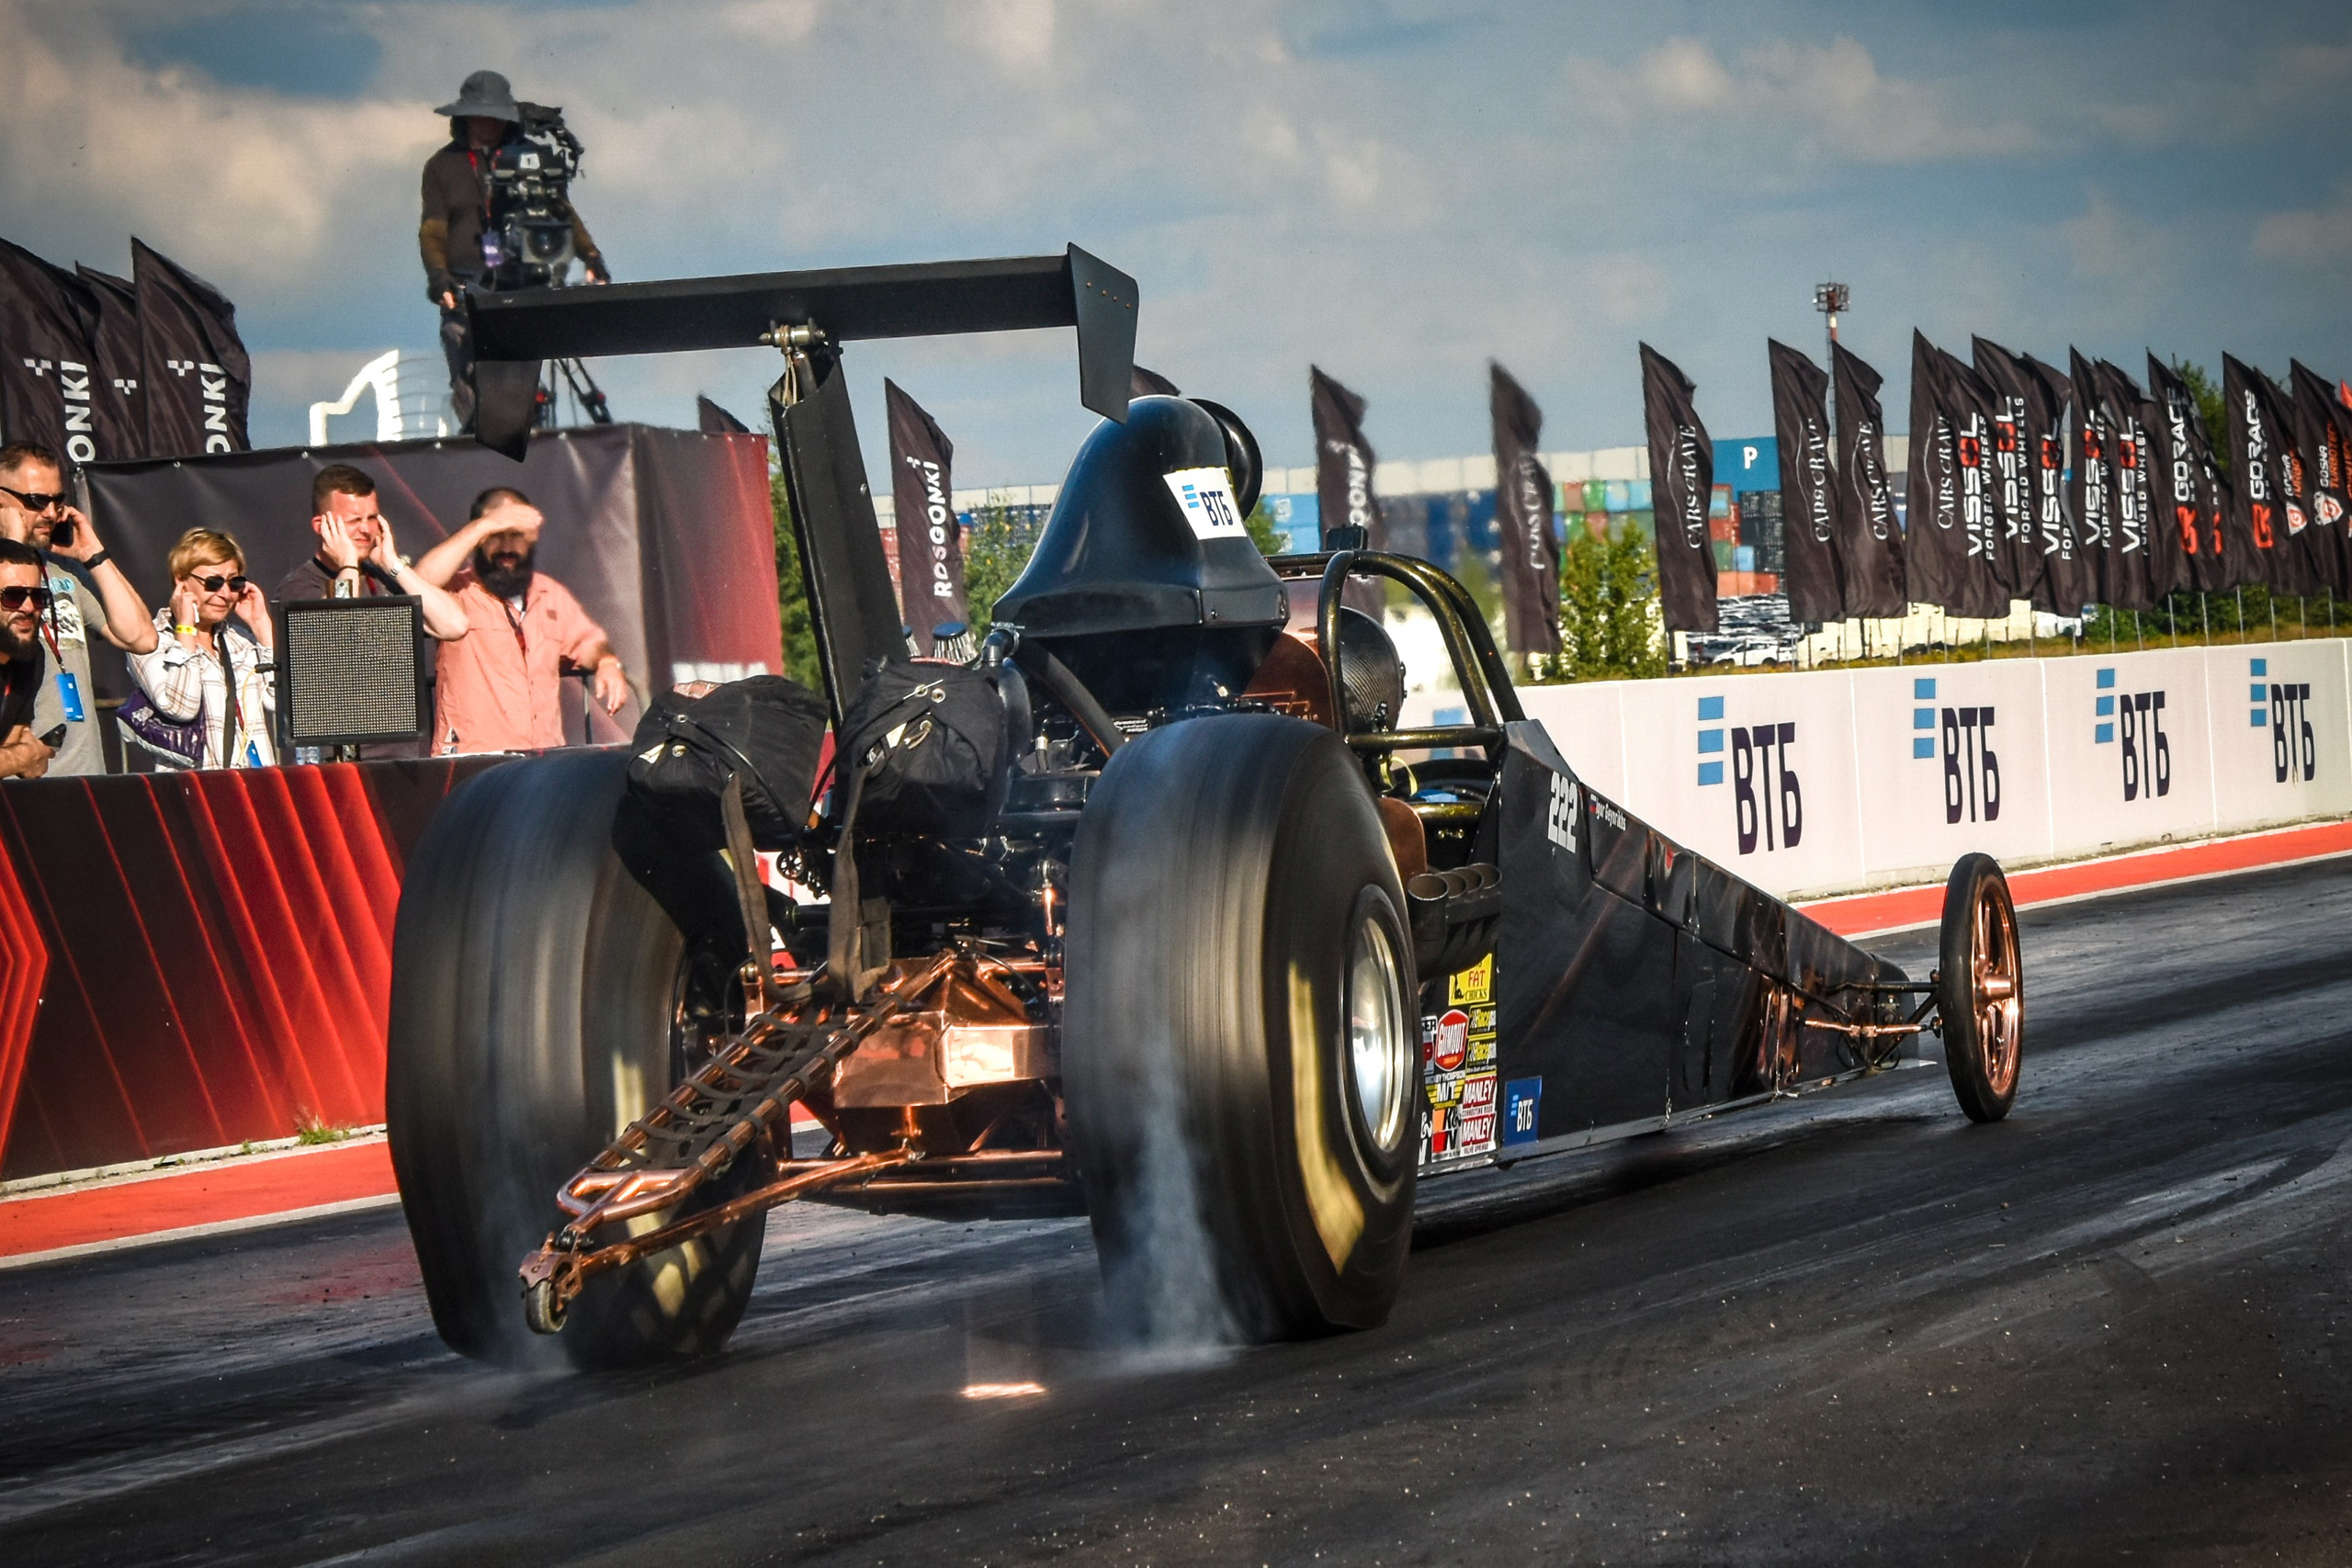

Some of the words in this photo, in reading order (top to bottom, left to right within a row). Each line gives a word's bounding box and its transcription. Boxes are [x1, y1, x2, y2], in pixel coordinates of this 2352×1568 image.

[1743, 446, 1758, 469] P
[1960, 412, 1983, 557] VISSOL
[1199, 491, 1234, 526] ВТБ
[2120, 691, 2170, 802] ВТБ
[2271, 683, 2316, 783] ВТБ
[1942, 706, 2001, 825] ВТБ
[1731, 722, 1803, 855] ВТБ
[1547, 770, 1578, 854] 222
[1464, 987, 1487, 1001] CHICKS
[1468, 969, 1486, 987] FAT
[1463, 1079, 1494, 1103] MANLEY
[1462, 1117, 1493, 1143] MANLEY
[1517, 1099, 1533, 1132] ВТБ
